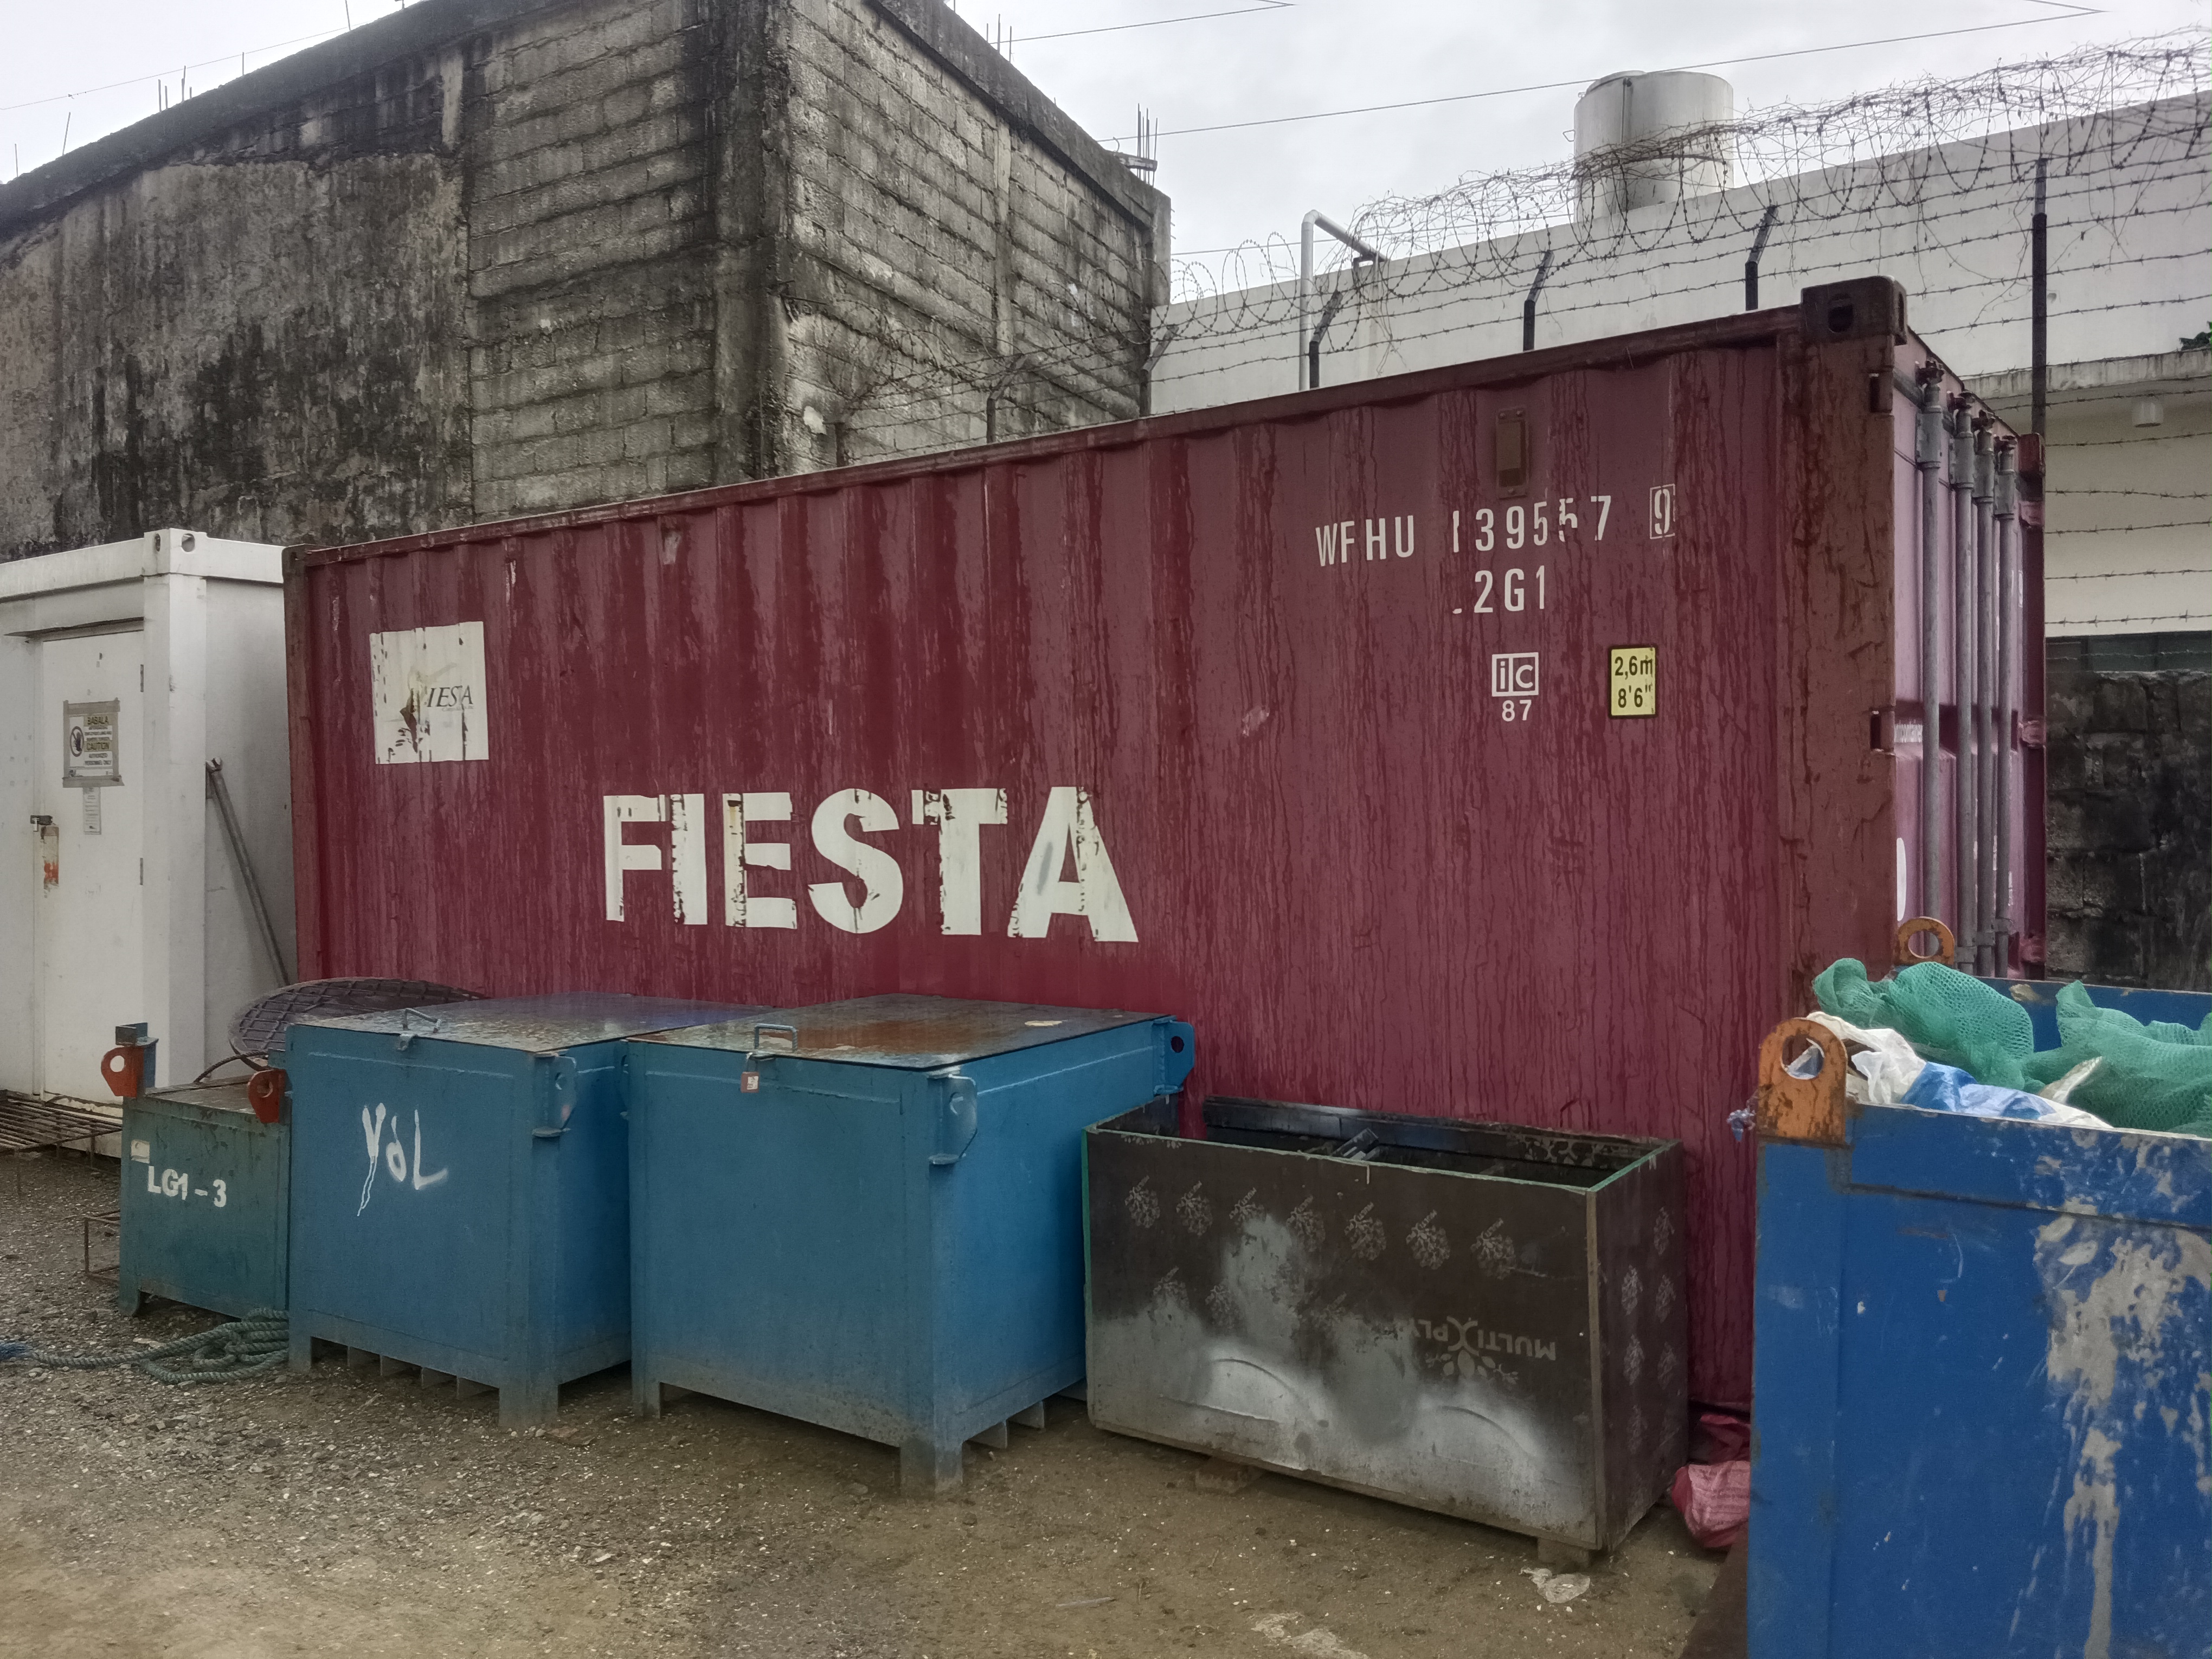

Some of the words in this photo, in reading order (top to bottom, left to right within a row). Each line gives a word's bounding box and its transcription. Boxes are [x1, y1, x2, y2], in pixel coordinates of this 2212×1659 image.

[1315, 515, 1414, 567] WFHU
[1452, 565, 1545, 614] 2G1
[1614, 655, 1654, 680] 2,6m
[1501, 699, 1532, 722] 87
[603, 786, 1139, 942] FIESTA
